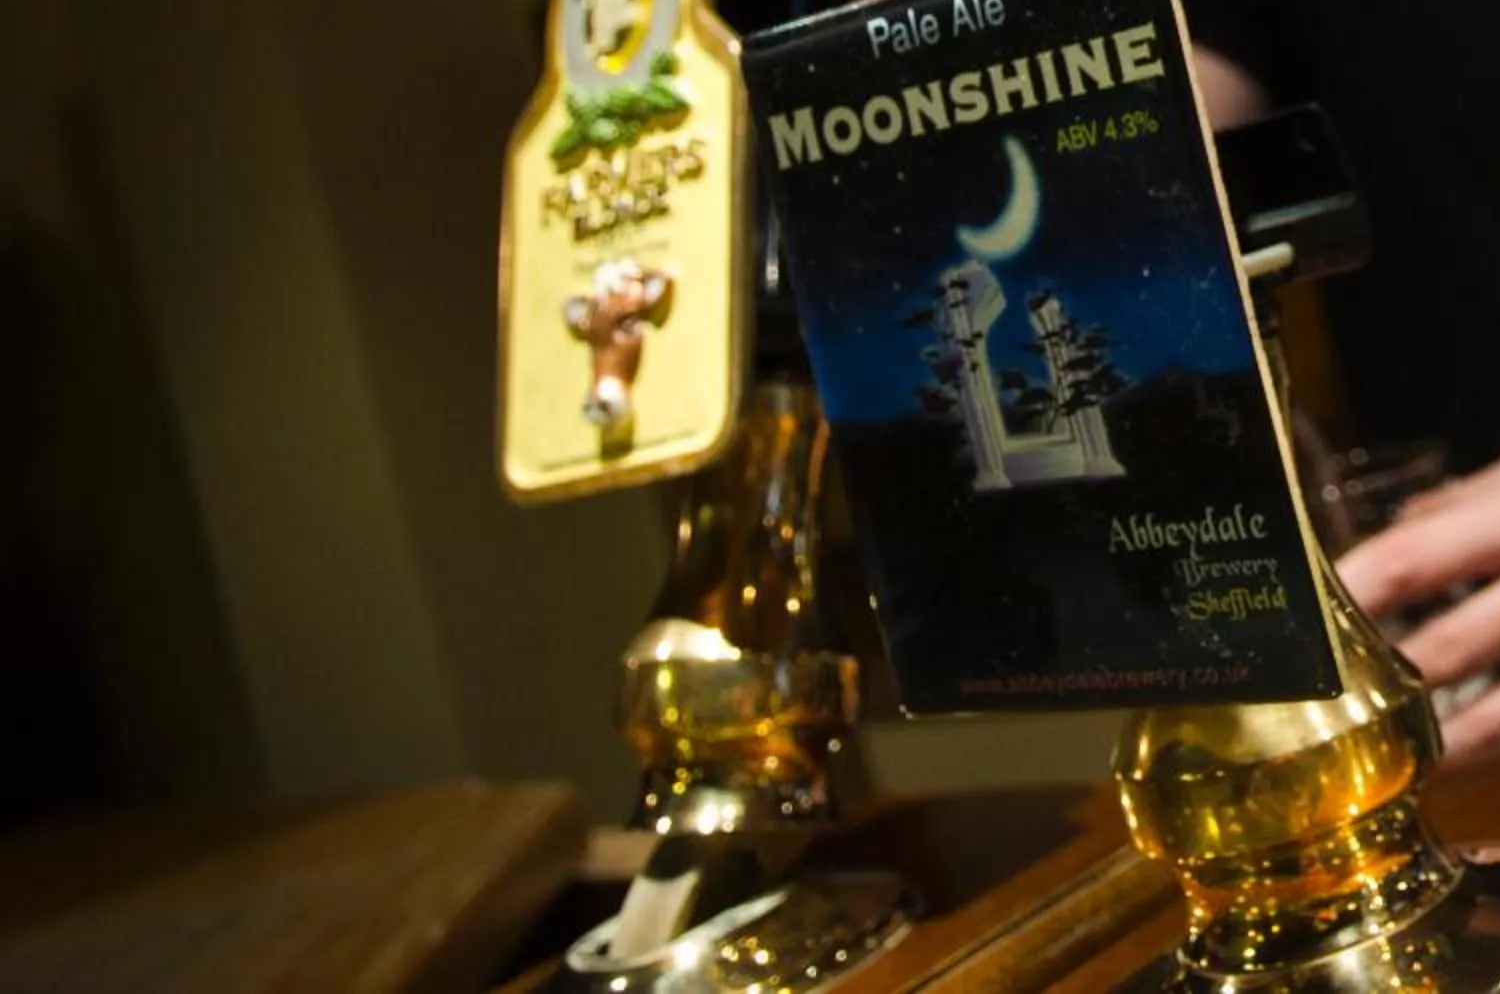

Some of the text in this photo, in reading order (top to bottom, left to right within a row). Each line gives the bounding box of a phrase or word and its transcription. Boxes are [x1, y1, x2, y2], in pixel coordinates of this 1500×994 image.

[866, 8, 940, 59] Pale
[767, 21, 1165, 171] MOONSHINE
[1056, 110, 1159, 154] ABV 4.3%
[1108, 504, 1268, 560] Abbeydale
[1174, 555, 1278, 588] Brewery
[1184, 585, 1287, 621] Sheffield
